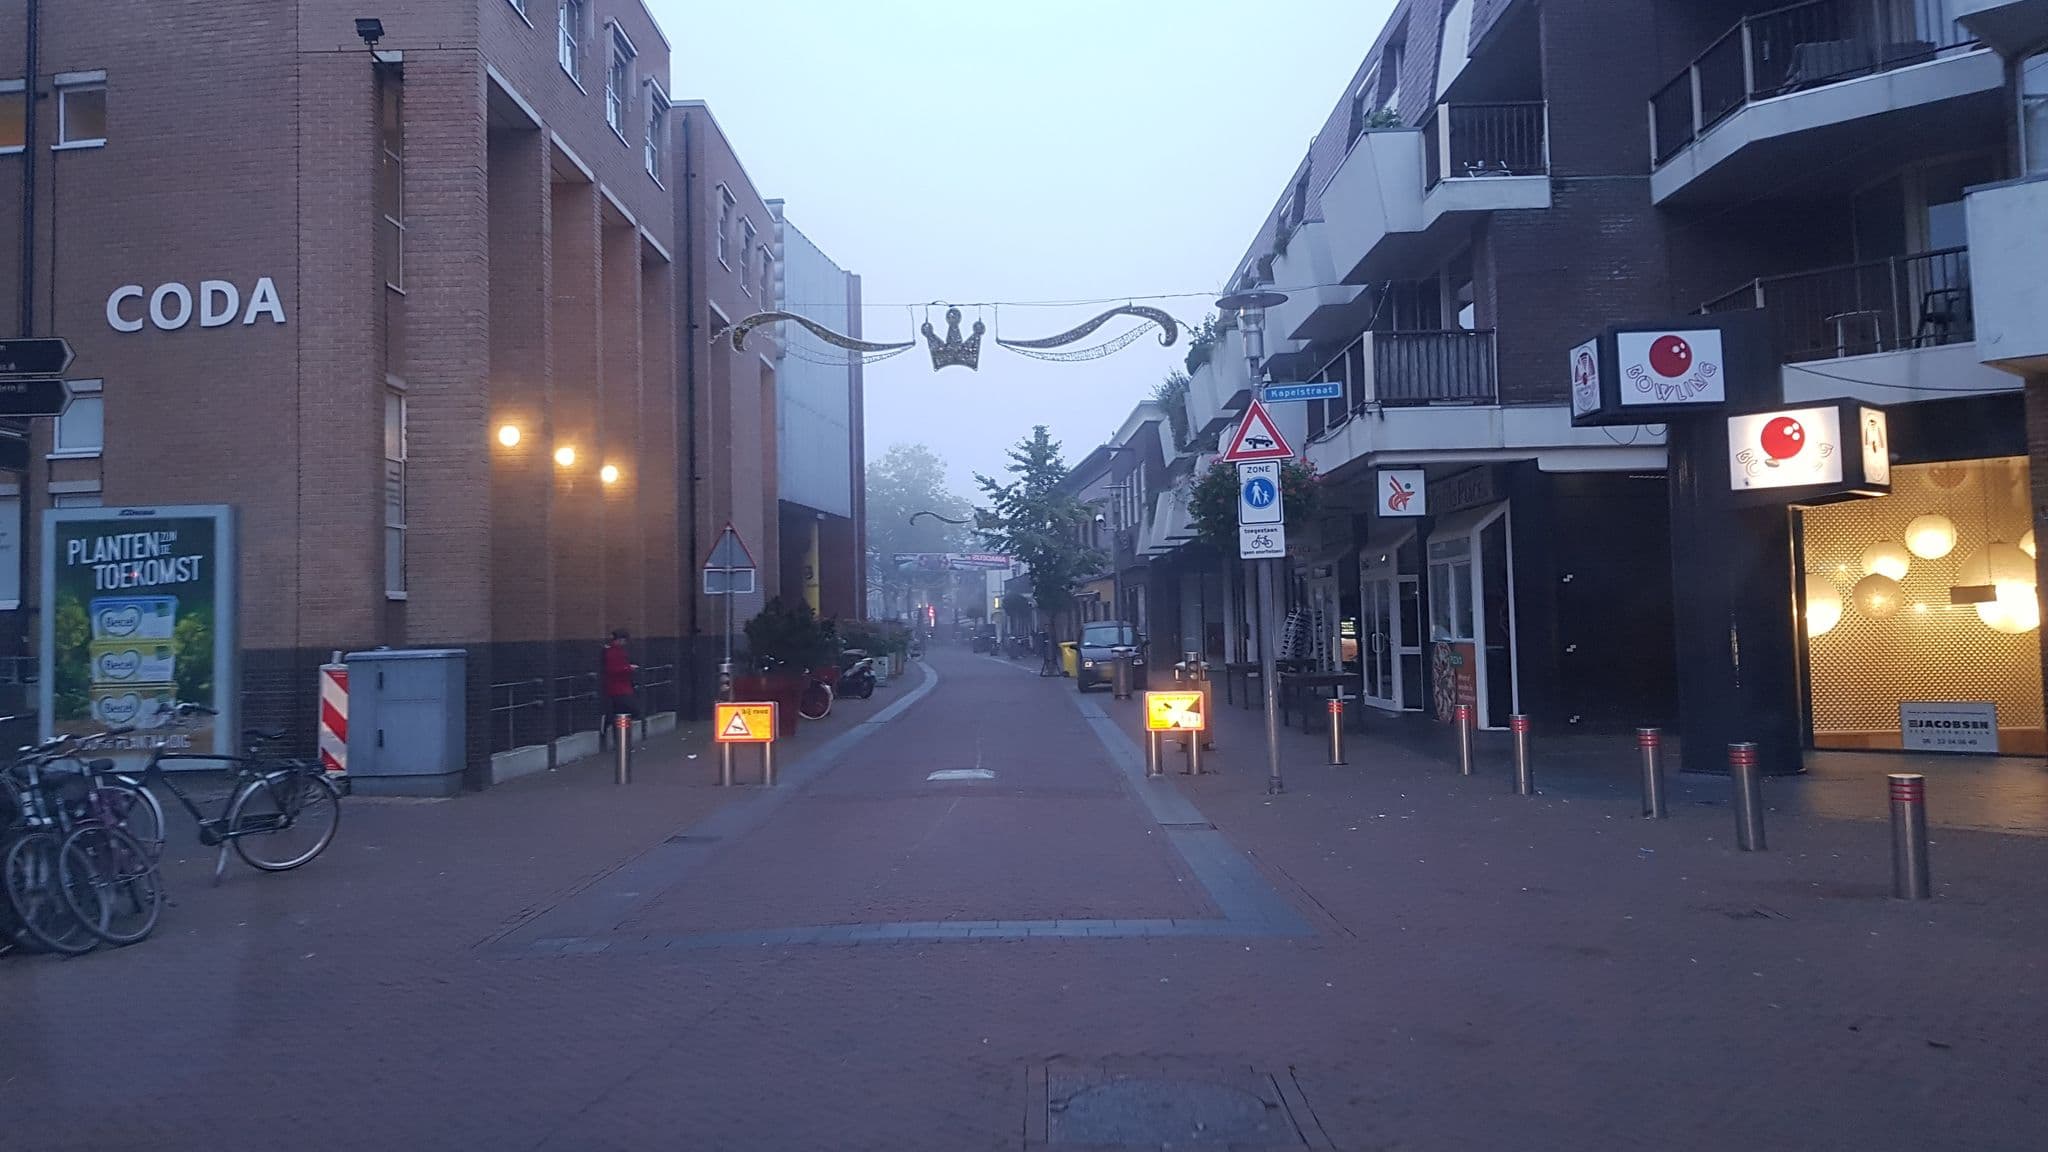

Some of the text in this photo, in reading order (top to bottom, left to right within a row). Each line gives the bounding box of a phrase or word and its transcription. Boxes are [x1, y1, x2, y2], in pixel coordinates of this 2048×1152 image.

[106, 277, 287, 333] CODA
[1271, 386, 1333, 398] Kapelstraat
[1626, 361, 1717, 401] BOWLING
[1247, 465, 1271, 473] ZONE
[67, 531, 161, 565] PLANTEN
[92, 555, 203, 590] TOEKOMST
